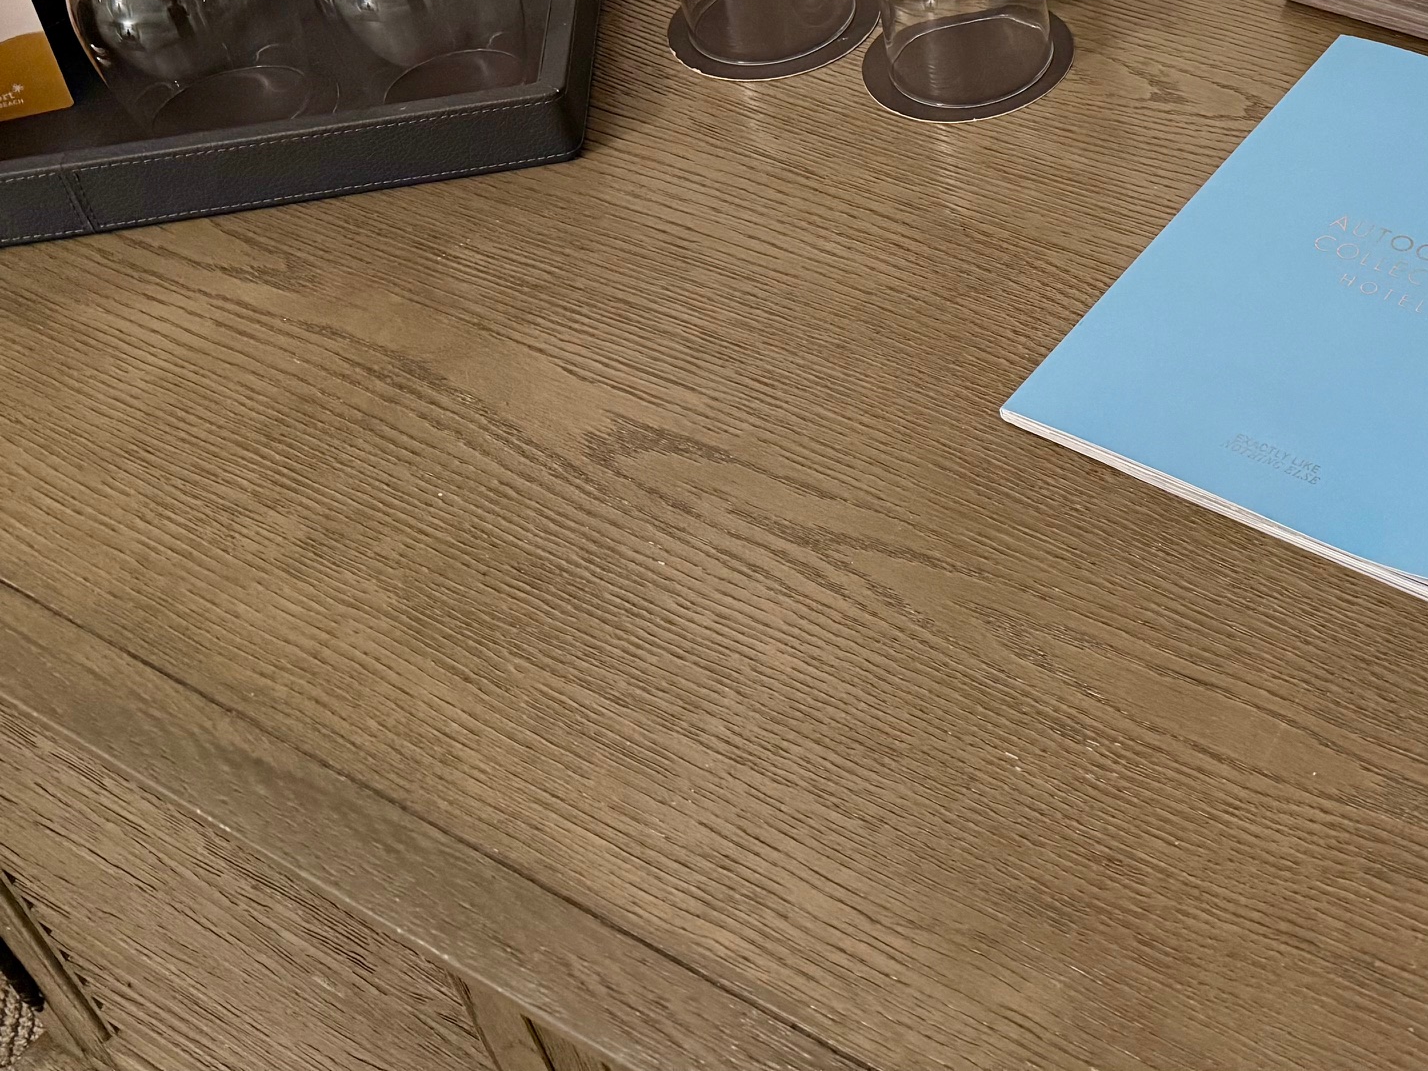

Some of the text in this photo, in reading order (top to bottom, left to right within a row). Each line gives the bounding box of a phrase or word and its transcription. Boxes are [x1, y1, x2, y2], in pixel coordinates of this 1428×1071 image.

[1219, 440, 1321, 485] NOTHING ELSE
[1233, 433, 1321, 474] EXACTLY LIKE
